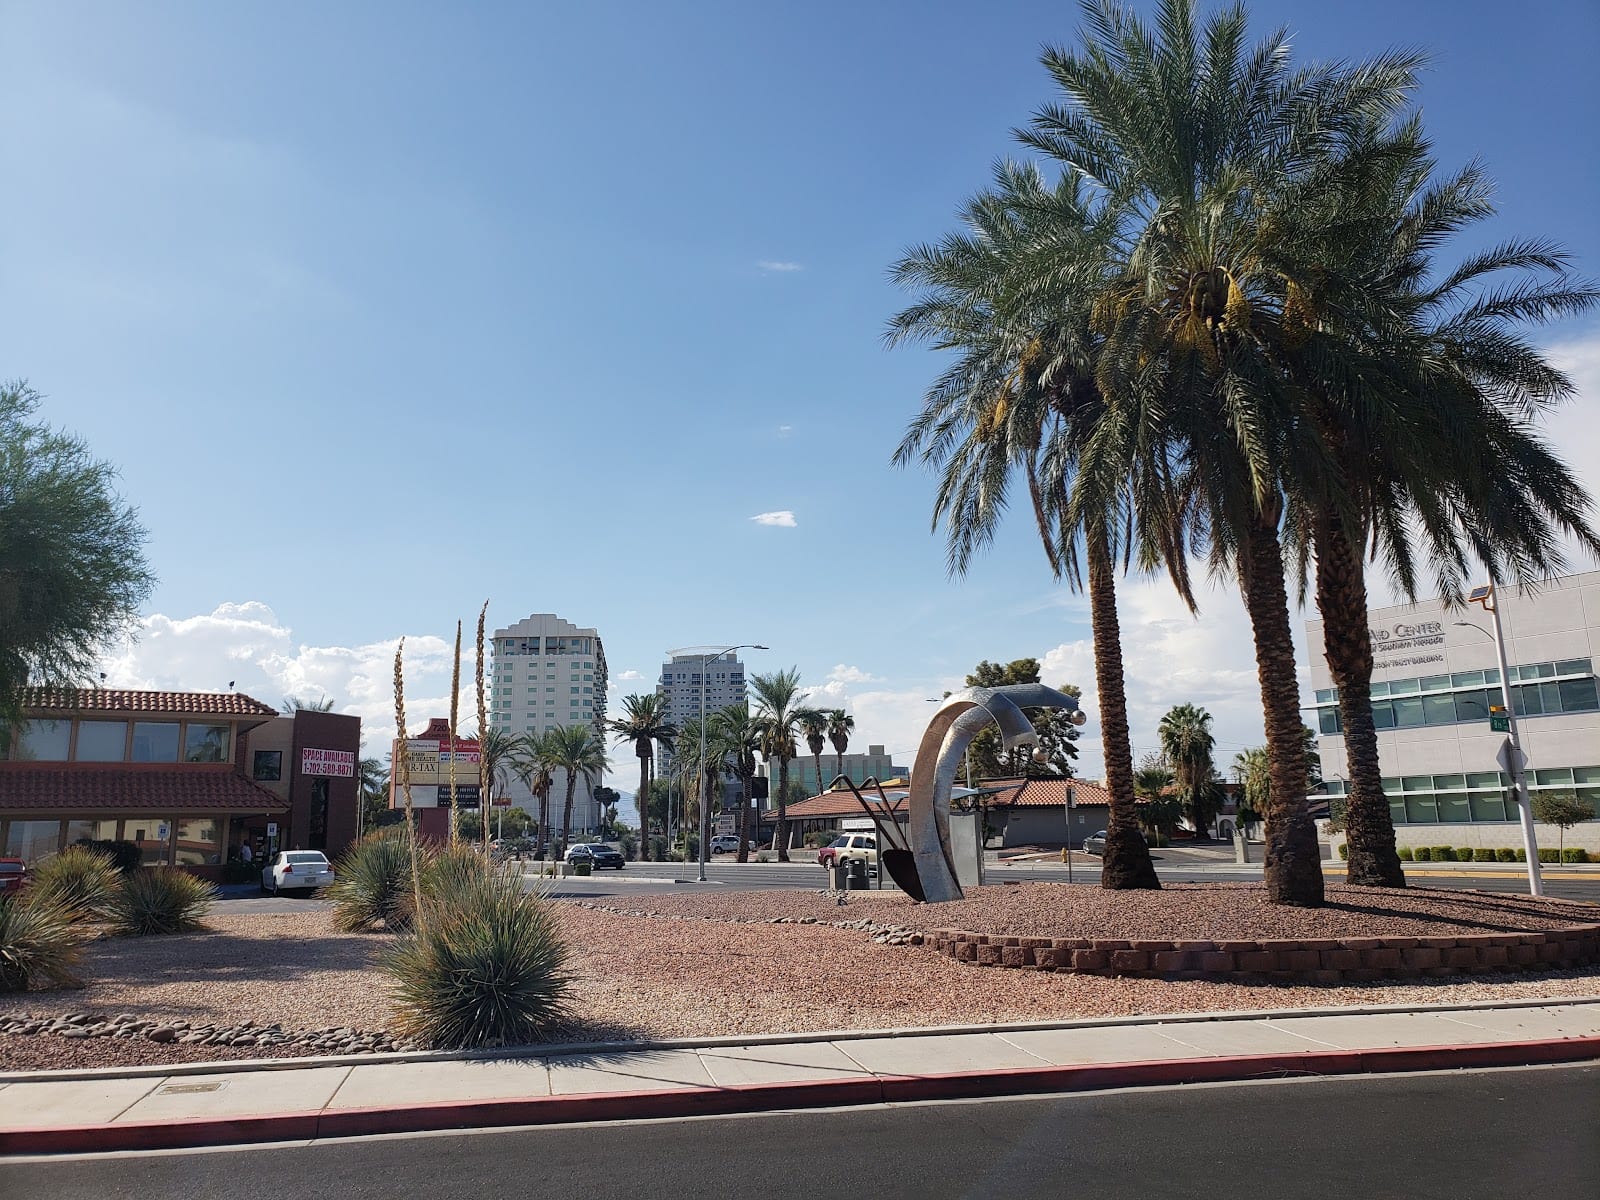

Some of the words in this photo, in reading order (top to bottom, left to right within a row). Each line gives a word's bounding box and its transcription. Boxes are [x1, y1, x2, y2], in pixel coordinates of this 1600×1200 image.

[1394, 621, 1442, 637] CENTER
[433, 724, 447, 732] 720
[303, 749, 323, 762] SPACE
[323, 751, 354, 764] AVAILABLE
